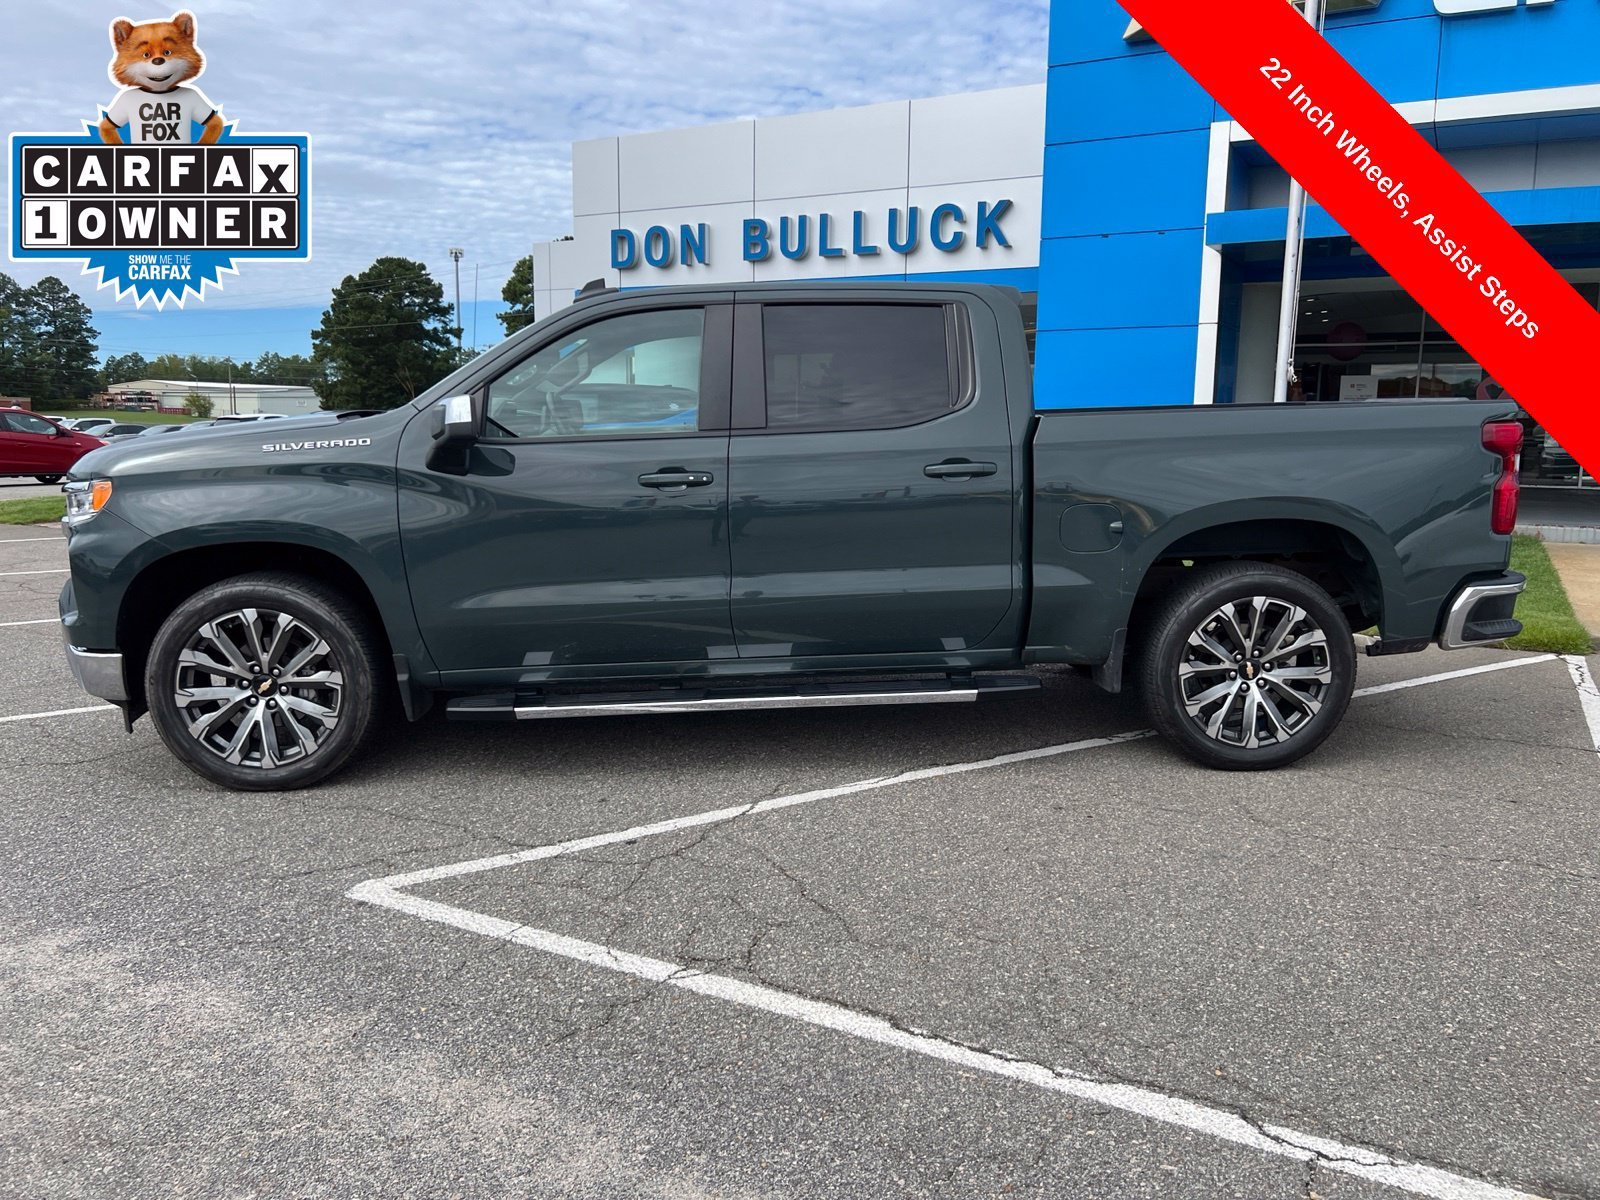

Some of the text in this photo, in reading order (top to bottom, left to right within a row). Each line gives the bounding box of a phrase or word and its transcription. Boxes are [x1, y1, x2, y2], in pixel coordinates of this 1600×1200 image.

[610, 199, 1014, 270] DON BULLUCK
[261, 437, 372, 452] SILVERADO
